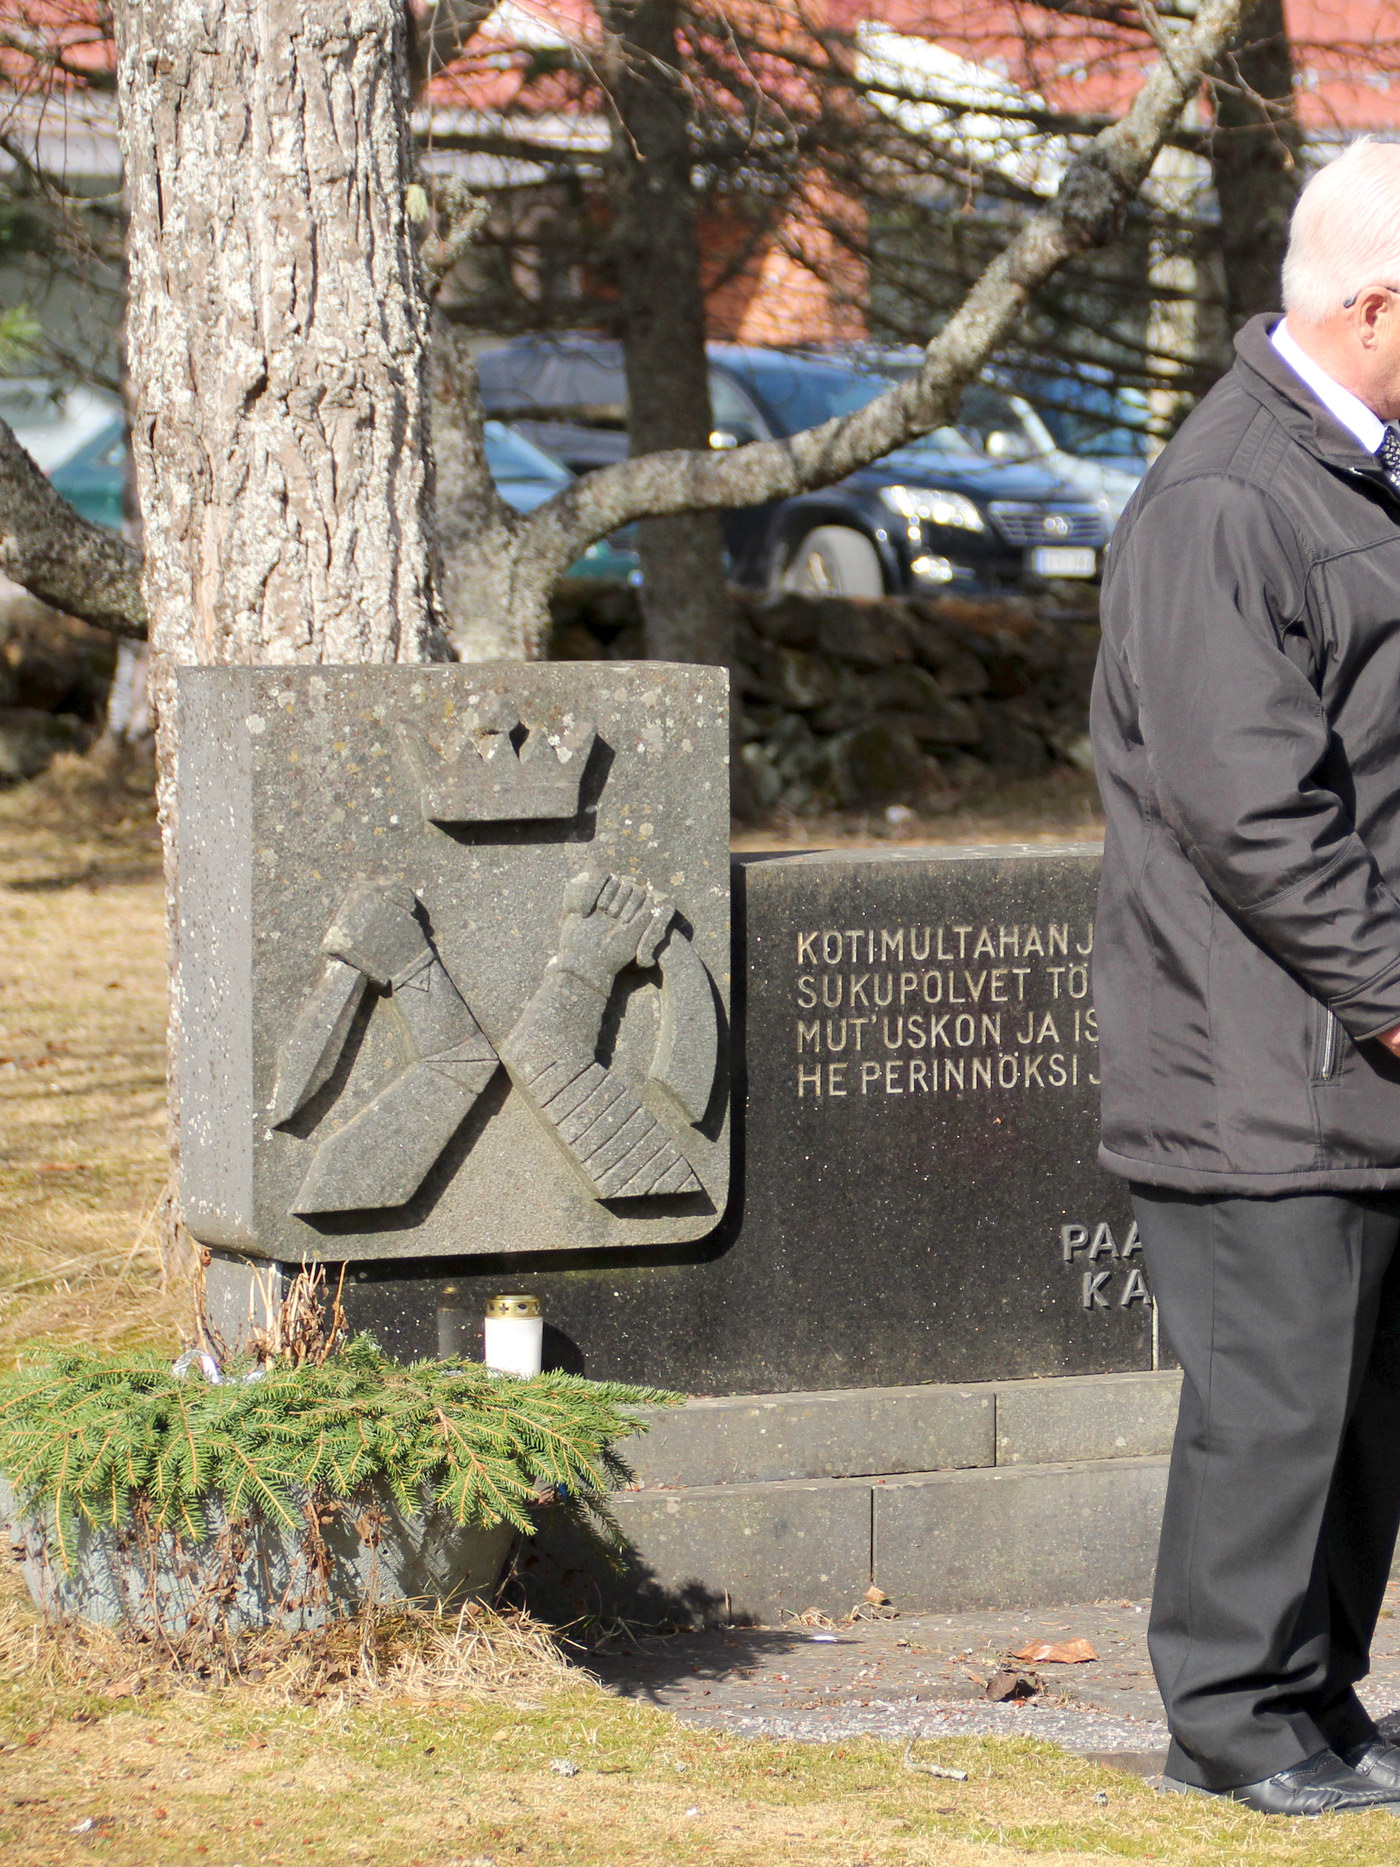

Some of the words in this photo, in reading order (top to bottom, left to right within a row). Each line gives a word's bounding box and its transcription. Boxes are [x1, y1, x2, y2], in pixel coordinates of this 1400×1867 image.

[797, 923, 1069, 965] KOTIMULTAHAN
[797, 968, 1031, 1008] SUKUPOLVET
[1046, 963, 1089, 1000] TÖ
[1016, 1011, 1061, 1044] JA
[1074, 1008, 1100, 1042] IS
[797, 1062, 848, 1098] HE
[861, 1051, 1078, 1095] PERINNÖKSI
[1061, 1221, 1143, 1261] PAA
[1082, 1269, 1152, 1309] KA
